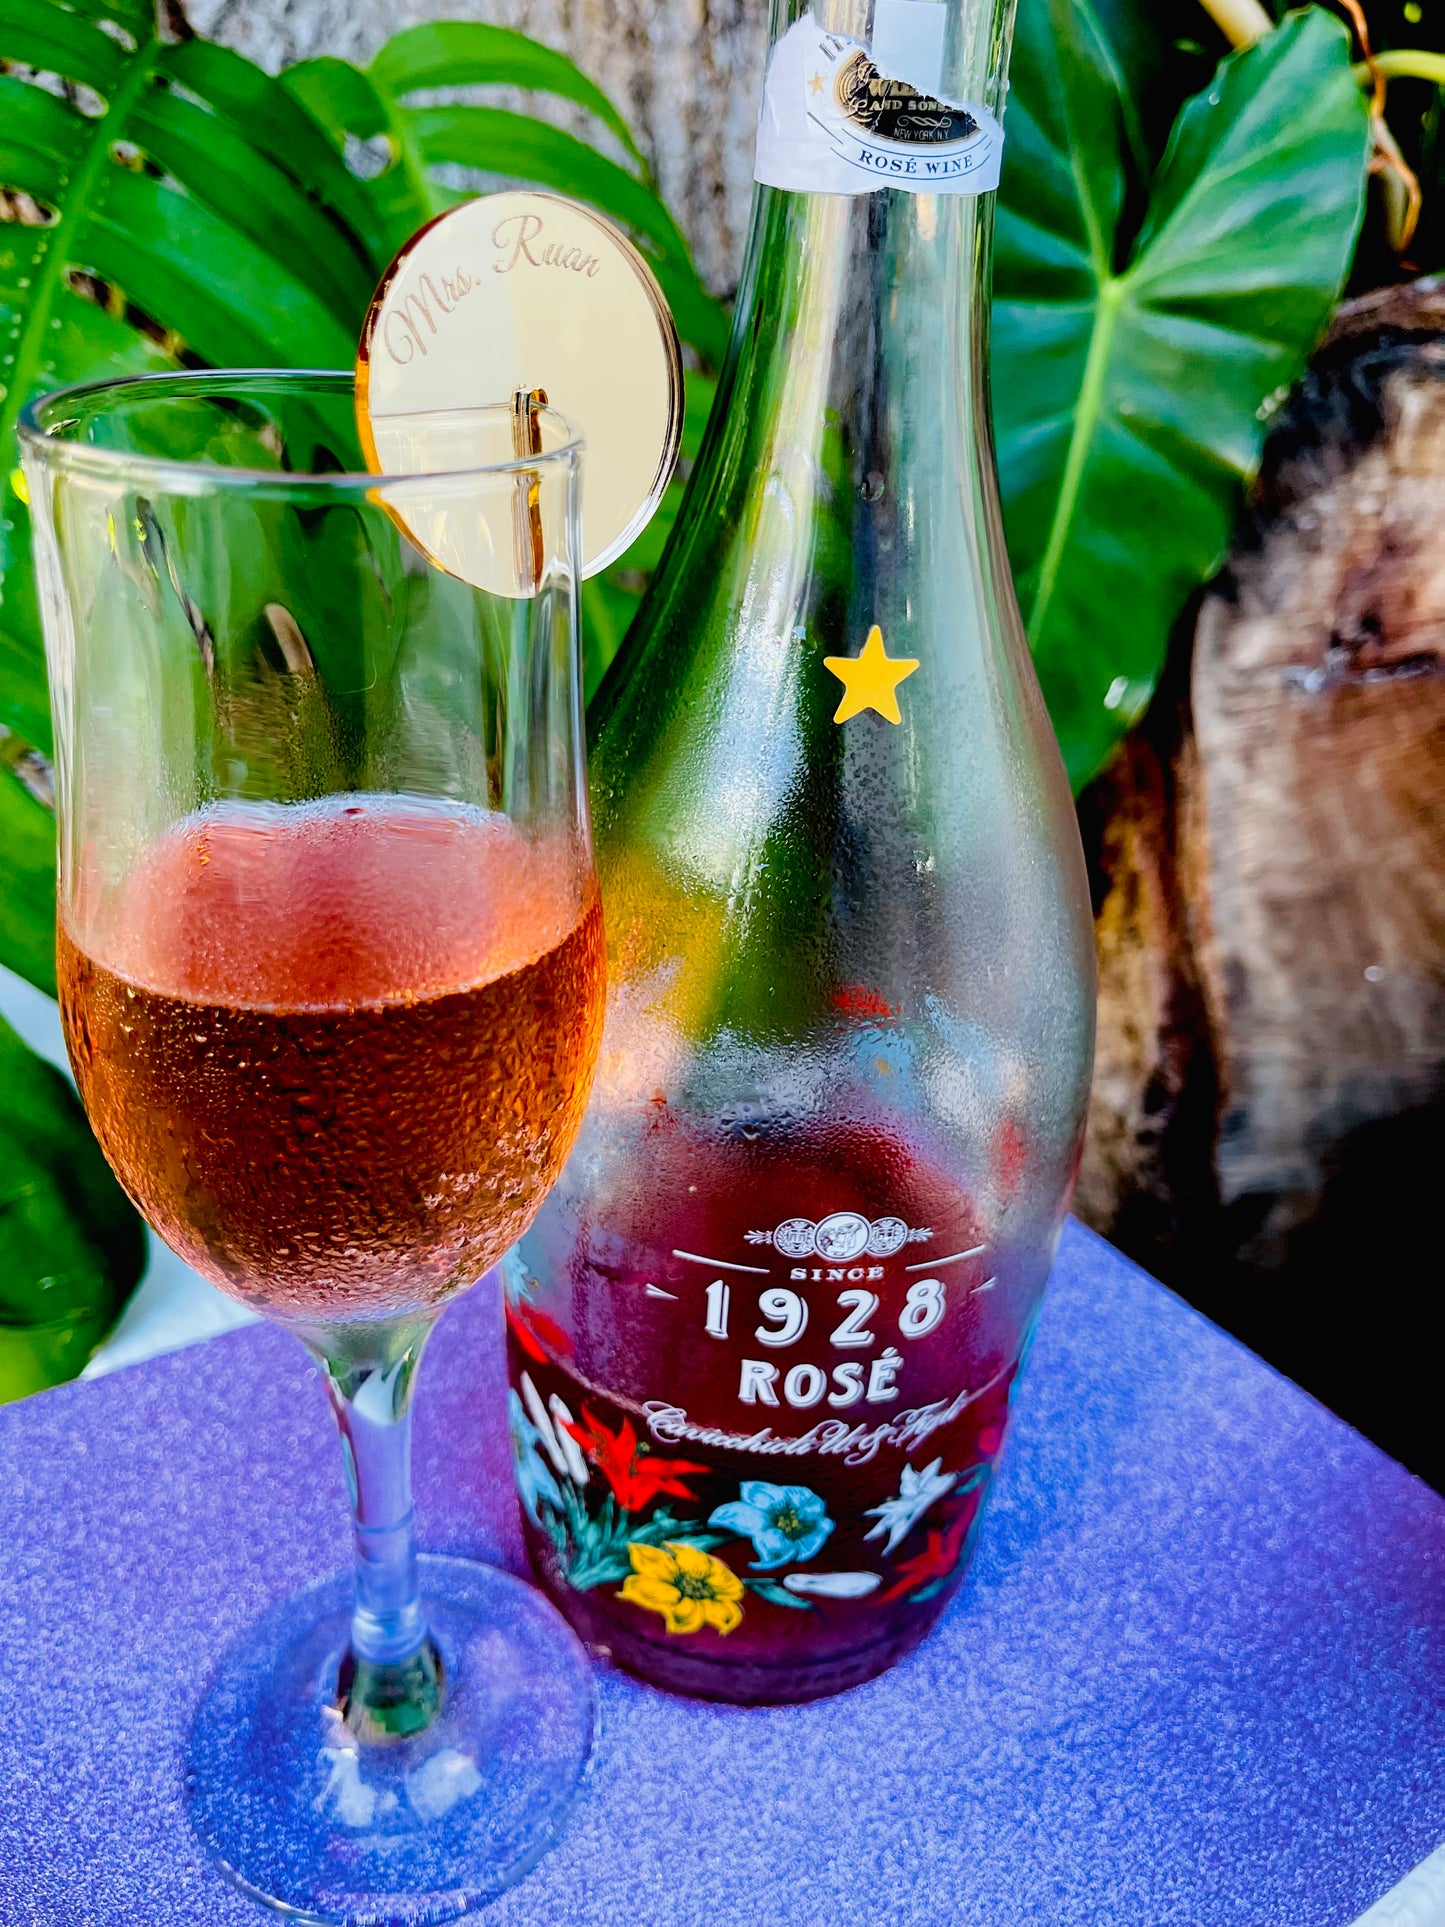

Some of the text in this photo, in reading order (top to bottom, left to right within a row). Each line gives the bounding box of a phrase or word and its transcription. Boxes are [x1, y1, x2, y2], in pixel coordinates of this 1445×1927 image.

[869, 100, 903, 112] AND
[893, 127, 912, 139] NEW
[858, 149, 974, 174] ROSÉ WINE
[383, 213, 601, 365] Mrs. Ruan
[790, 1266, 885, 1281] SINCE
[704, 1278, 947, 1349] 1928
[737, 1346, 905, 1409] ROSÉ
